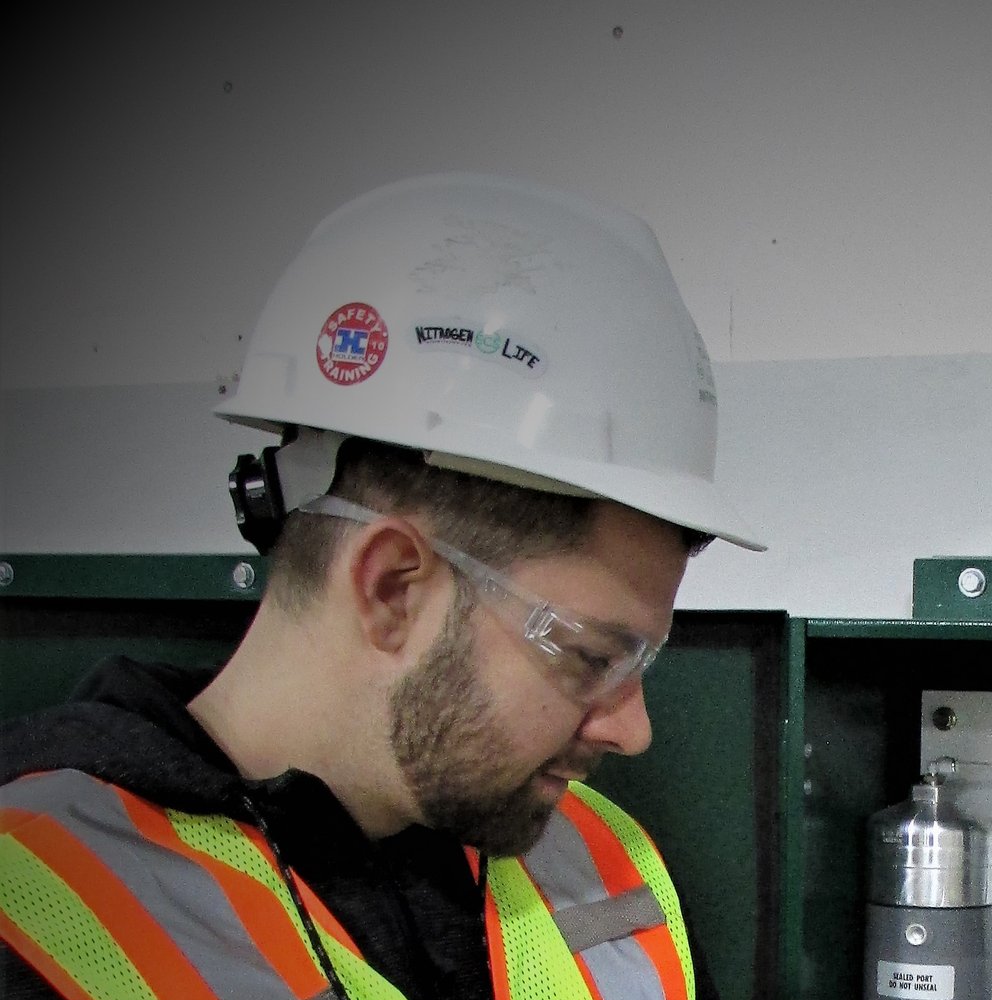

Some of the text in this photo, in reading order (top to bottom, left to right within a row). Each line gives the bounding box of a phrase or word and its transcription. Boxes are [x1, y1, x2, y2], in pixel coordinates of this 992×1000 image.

[328, 308, 381, 332] SAFETY
[502, 338, 540, 368] LIFE
[889, 980, 937, 992] DO NOT UNSEAL
[893, 972, 933, 983] SEALED PORT
